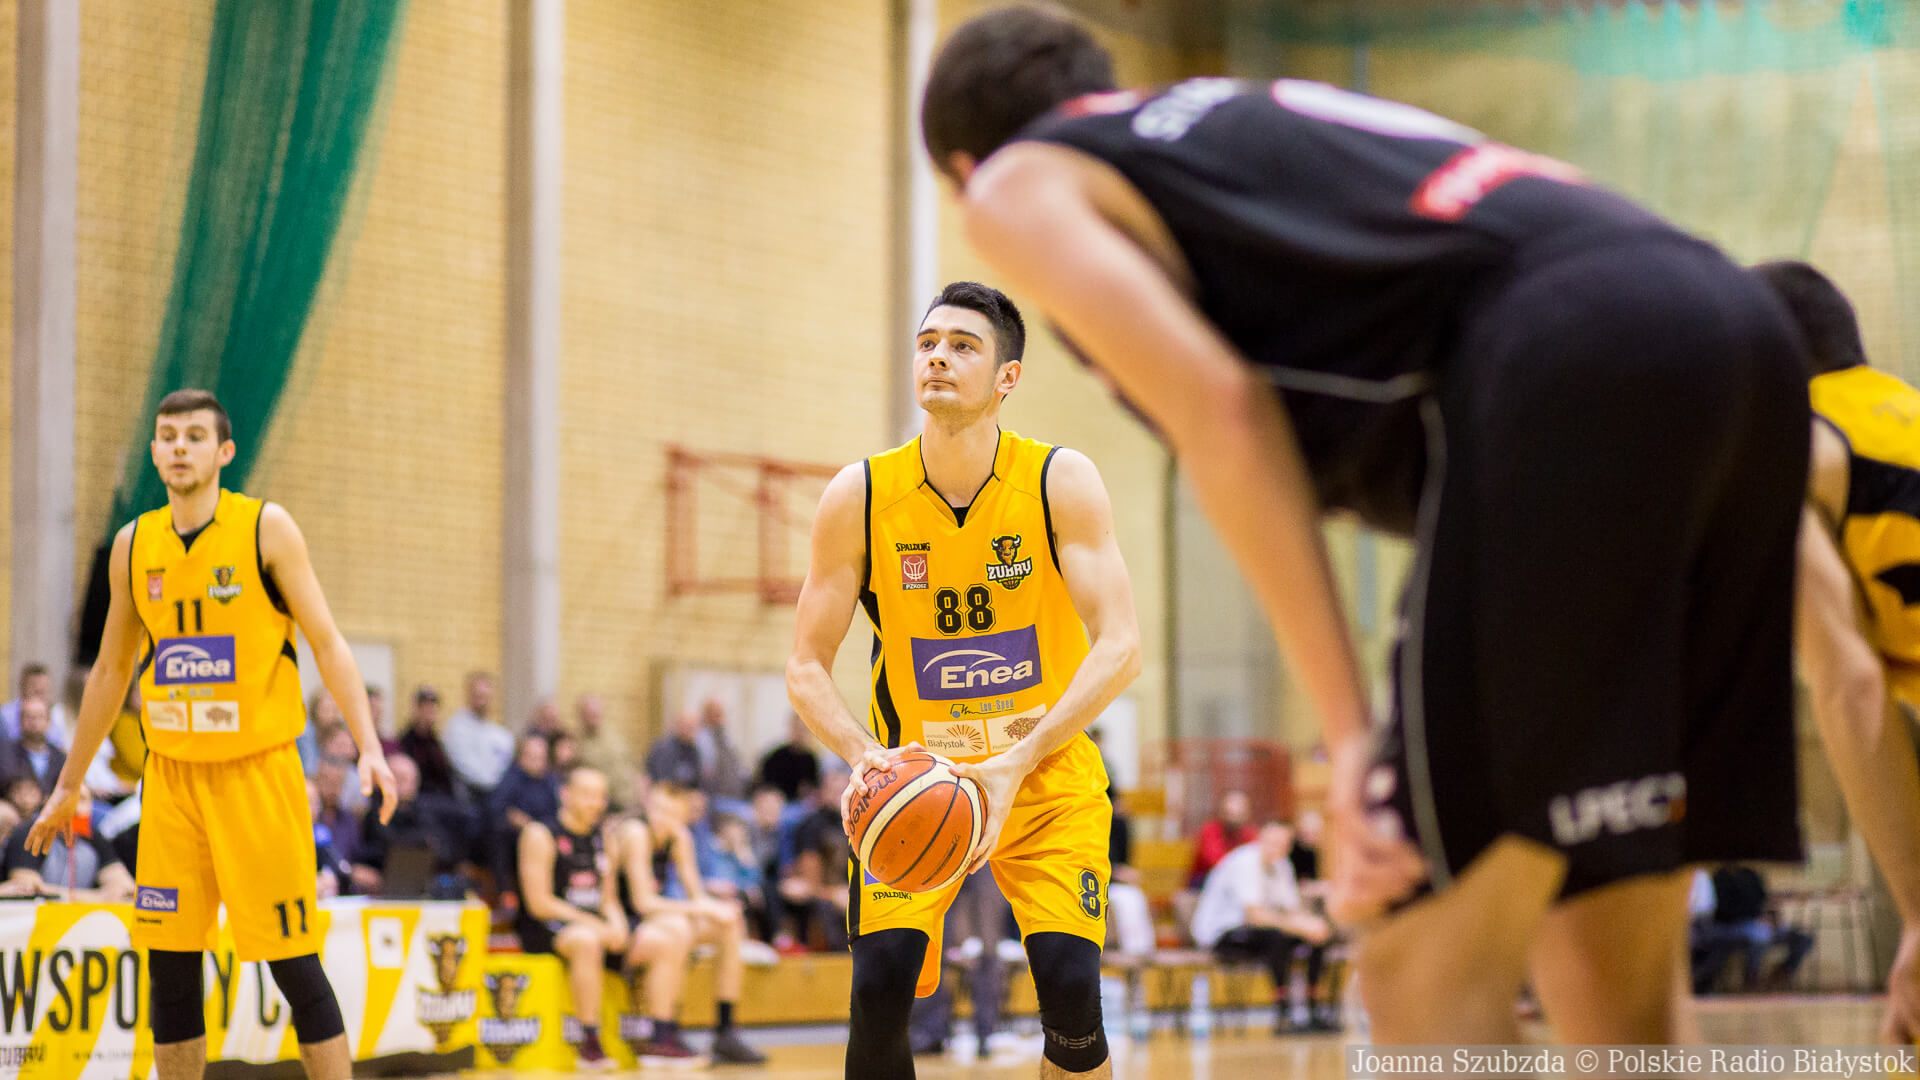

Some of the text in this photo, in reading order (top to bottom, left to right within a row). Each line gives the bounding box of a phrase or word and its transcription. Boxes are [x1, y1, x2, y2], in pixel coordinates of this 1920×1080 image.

[896, 542, 931, 552] SPALDING
[987, 559, 1031, 580] ZUBRY
[173, 600, 204, 633] 11
[934, 583, 996, 636] 88
[165, 656, 231, 679] Enea
[940, 660, 1033, 689] Enea
[927, 739, 966, 750] Białystok
[873, 891, 912, 901] SPALDING
[274, 898, 308, 938] 11
